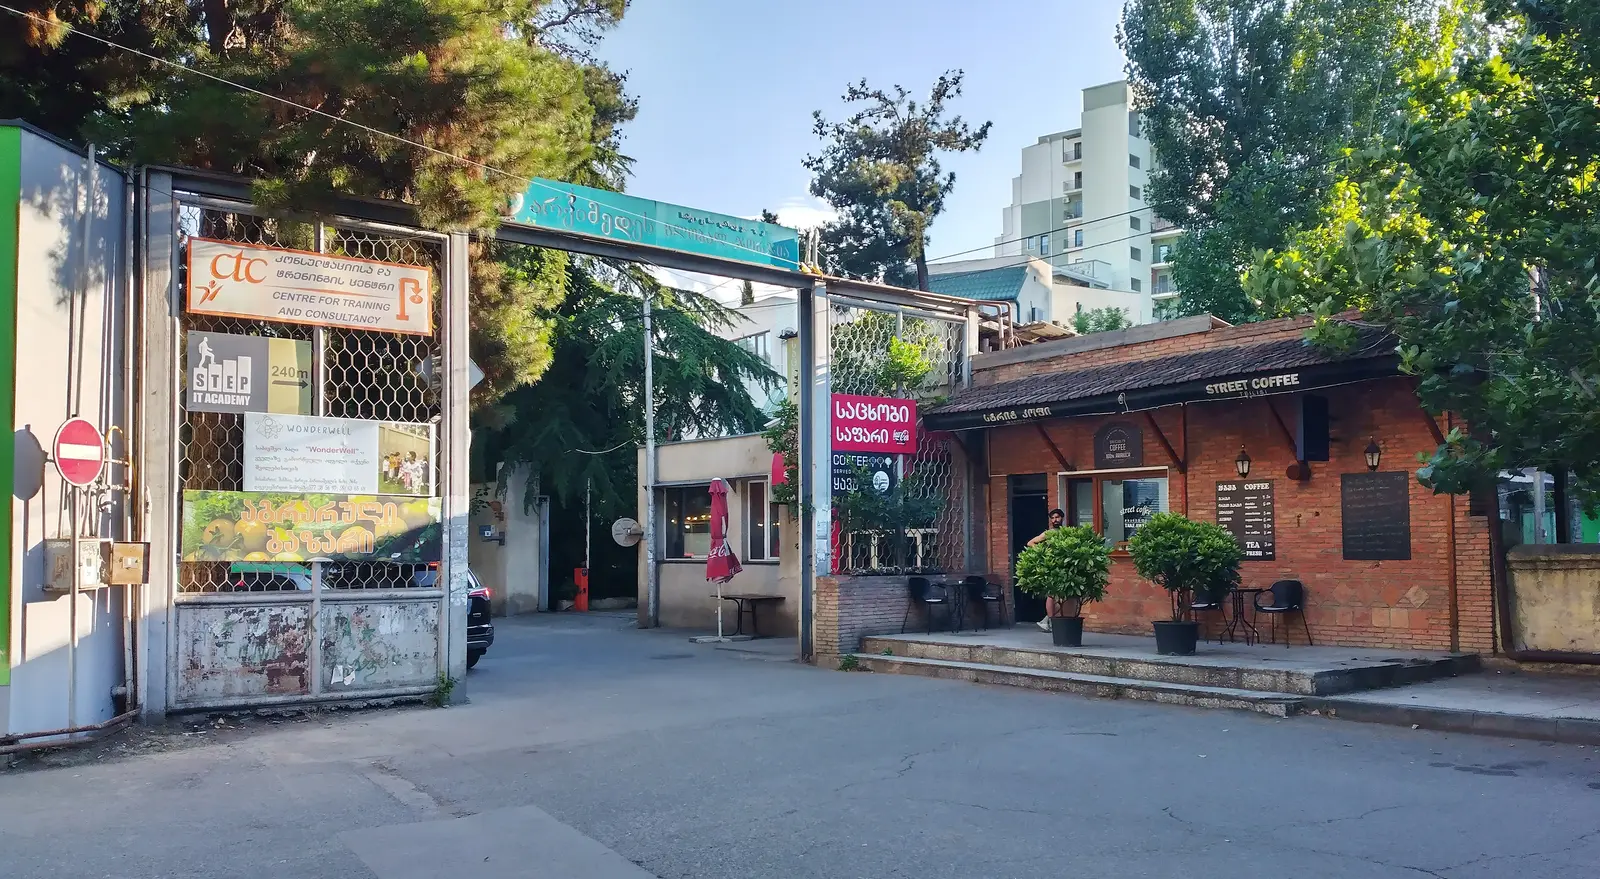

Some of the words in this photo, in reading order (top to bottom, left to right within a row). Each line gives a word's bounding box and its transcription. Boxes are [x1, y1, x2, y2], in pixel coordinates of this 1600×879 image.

[275, 255, 374, 277] კონსულტაციისა
[377, 267, 392, 278] და
[276, 268, 344, 286] ტრენინგის
[350, 277, 395, 292] ცენტრი
[272, 291, 315, 304] CENTRE
[318, 296, 340, 306] FOR
[343, 299, 391, 312] TRAINING
[278, 307, 302, 317] AND
[305, 309, 381, 324] CONSULTANCY
[196, 373, 249, 391] STEP
[1205, 380, 1248, 394] STREET
[1251, 373, 1300, 389] COFFEE
[193, 392, 204, 403] IT
[204, 393, 251, 406] ACADEMY
[835, 401, 909, 422] საცხობი
[983, 410, 1018, 422] სტრიტ
[1022, 406, 1052, 418] კოფი
[836, 426, 889, 444] საფარი
[240, 499, 399, 525] აგრარული
[265, 528, 375, 554] ბაზარი
[1245, 541, 1260, 549] TEA
